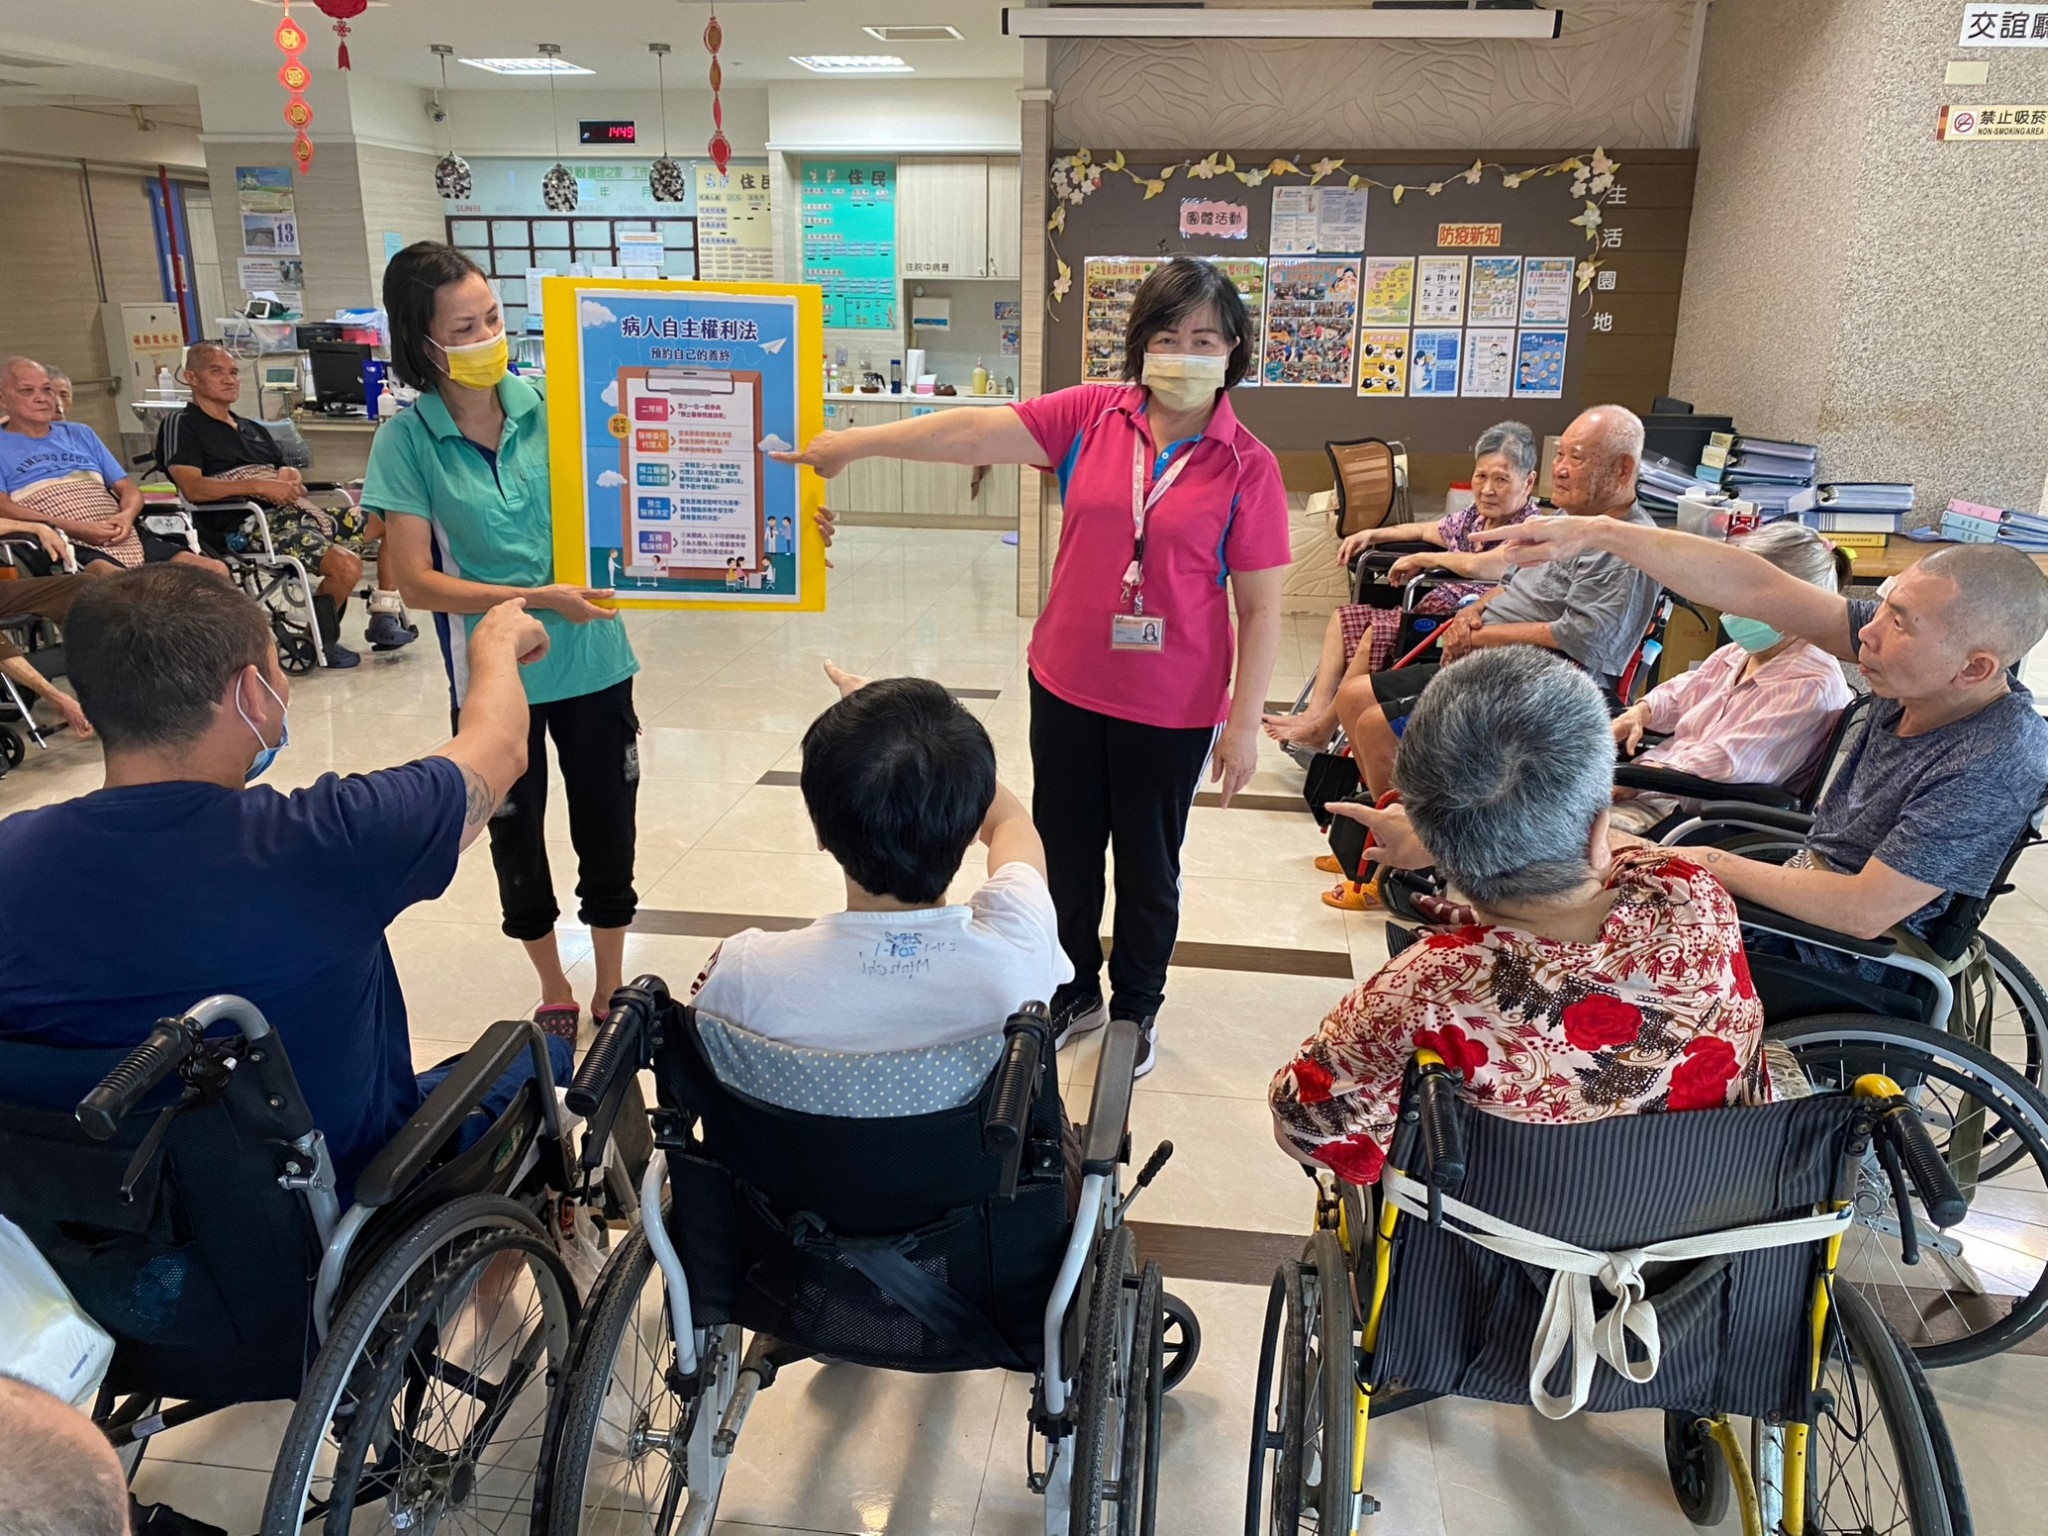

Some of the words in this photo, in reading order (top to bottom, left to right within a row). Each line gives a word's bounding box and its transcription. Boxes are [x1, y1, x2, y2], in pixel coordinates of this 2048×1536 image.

[1980, 110, 2047, 125] 禁止吸菸
[1978, 128, 2025, 136] NON-SMOKING
[2025, 128, 2045, 136] AREA
[848, 168, 886, 188] 住民
[1186, 211, 1241, 226] 團體活動
[276, 222, 294, 243] 13
[1440, 226, 1499, 244] 防疫新知
[1592, 184, 1627, 331] 生活園地
[621, 316, 759, 341] 病人自主權利法
[651, 347, 731, 362] 預約自己的善終
[641, 441, 663, 449] 代理人
[639, 466, 667, 474] 預立醫療
[647, 500, 662, 508] 預立
[640, 508, 669, 517] 醫療決定
[649, 533, 663, 542] 五種
